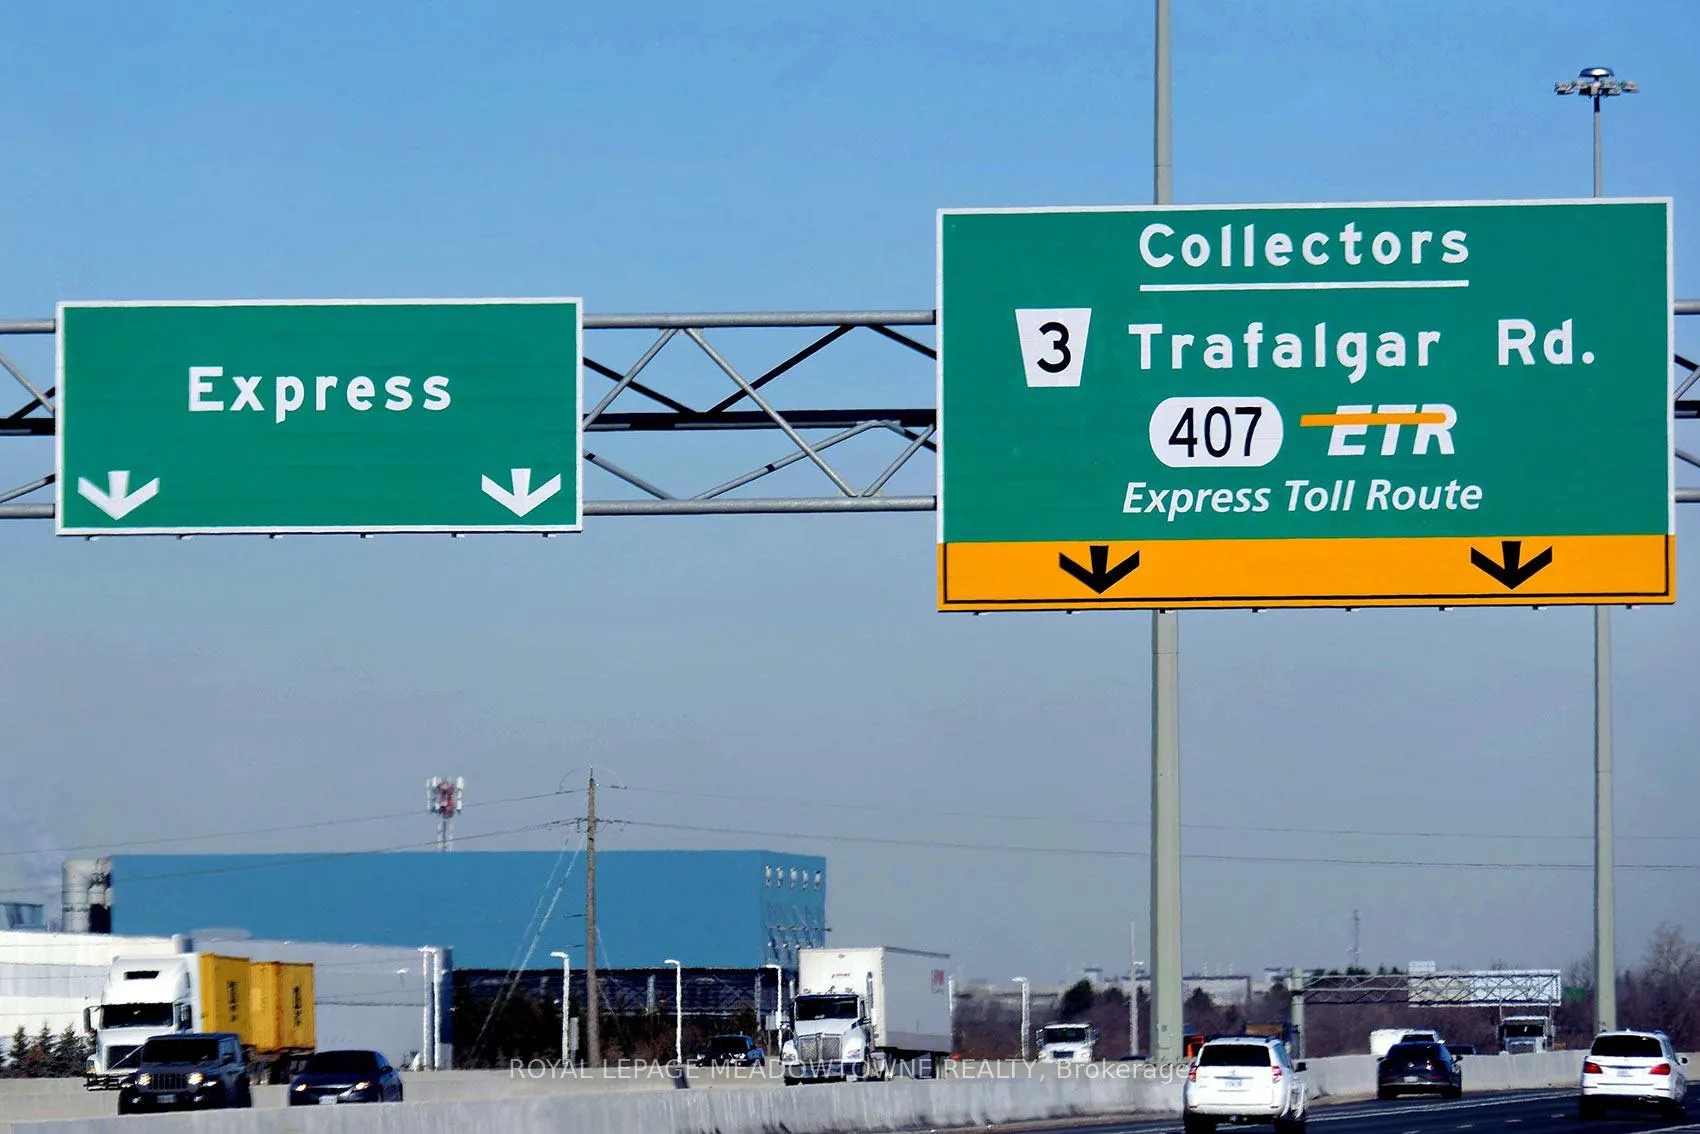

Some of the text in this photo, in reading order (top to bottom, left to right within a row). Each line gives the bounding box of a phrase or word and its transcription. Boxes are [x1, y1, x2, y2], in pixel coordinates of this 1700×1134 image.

[1139, 222, 1469, 268] Collectors
[1036, 321, 1071, 373] 3
[1128, 319, 1596, 384] Trafalgar Rd.
[188, 366, 452, 424] Express
[1168, 404, 1457, 458] 407 ETR
[1122, 479, 1483, 522] Express Toll Route
